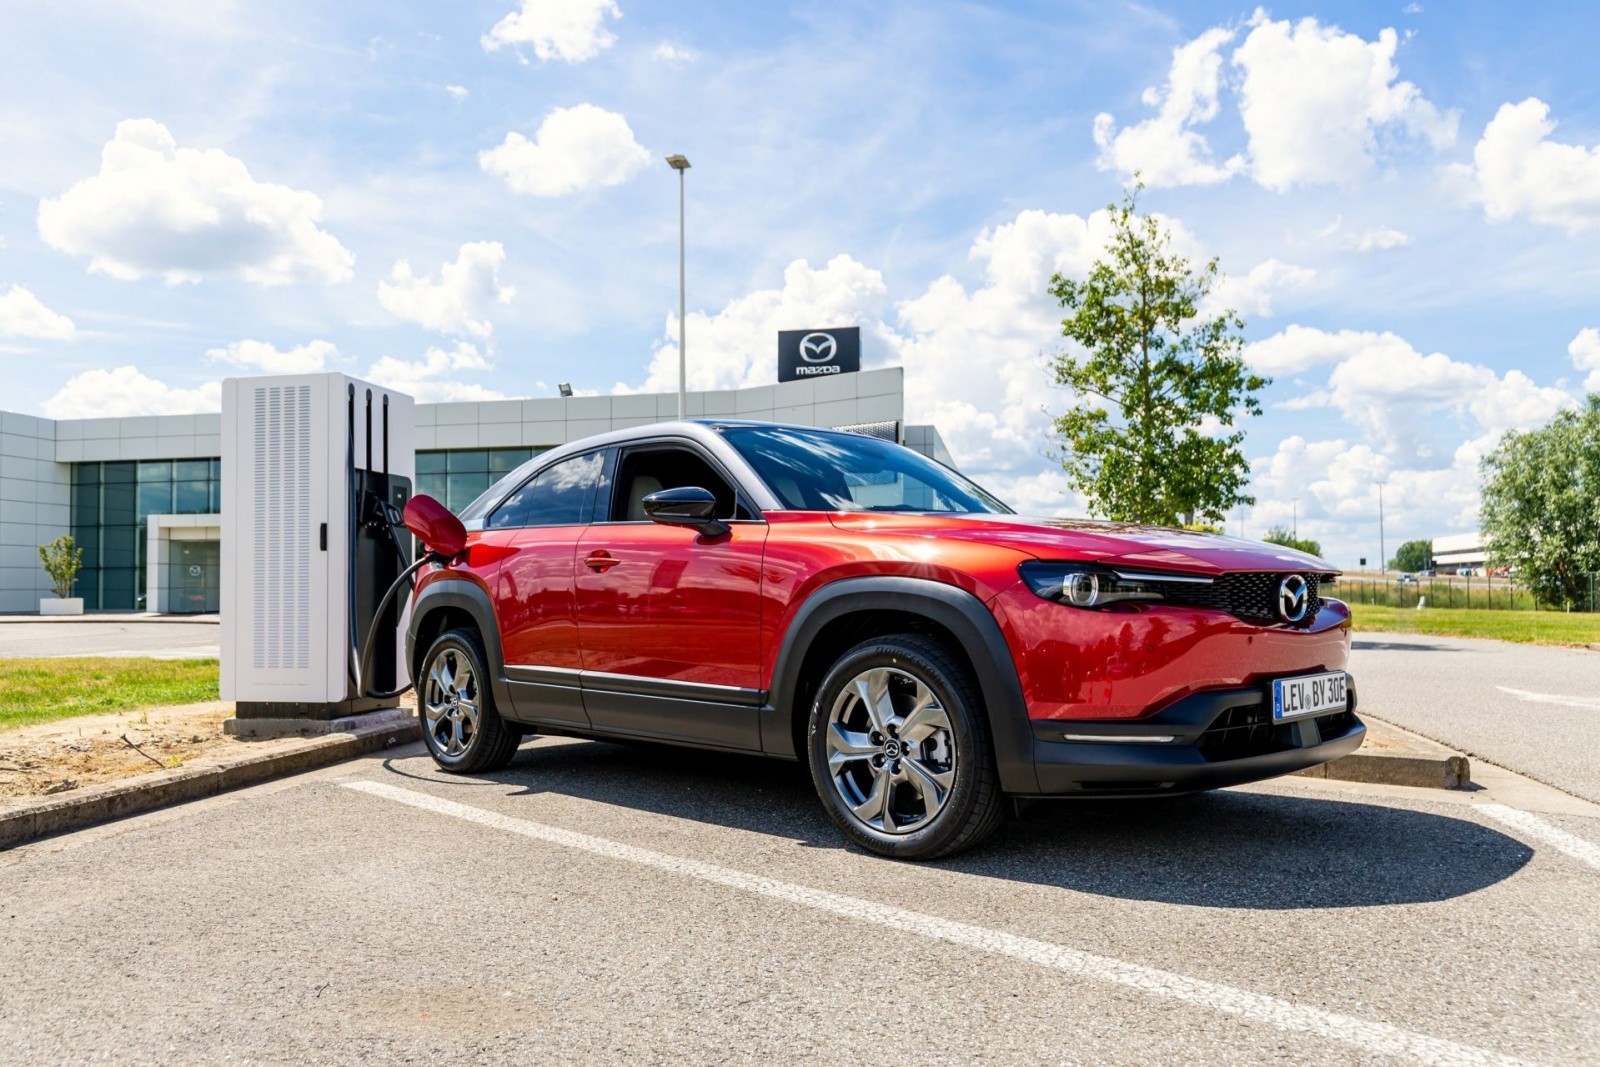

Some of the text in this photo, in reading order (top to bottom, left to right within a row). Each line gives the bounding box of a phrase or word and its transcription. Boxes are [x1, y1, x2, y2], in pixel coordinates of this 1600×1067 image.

[796, 365, 840, 375] mazda
[1283, 677, 1345, 712] LEV BY 30E
